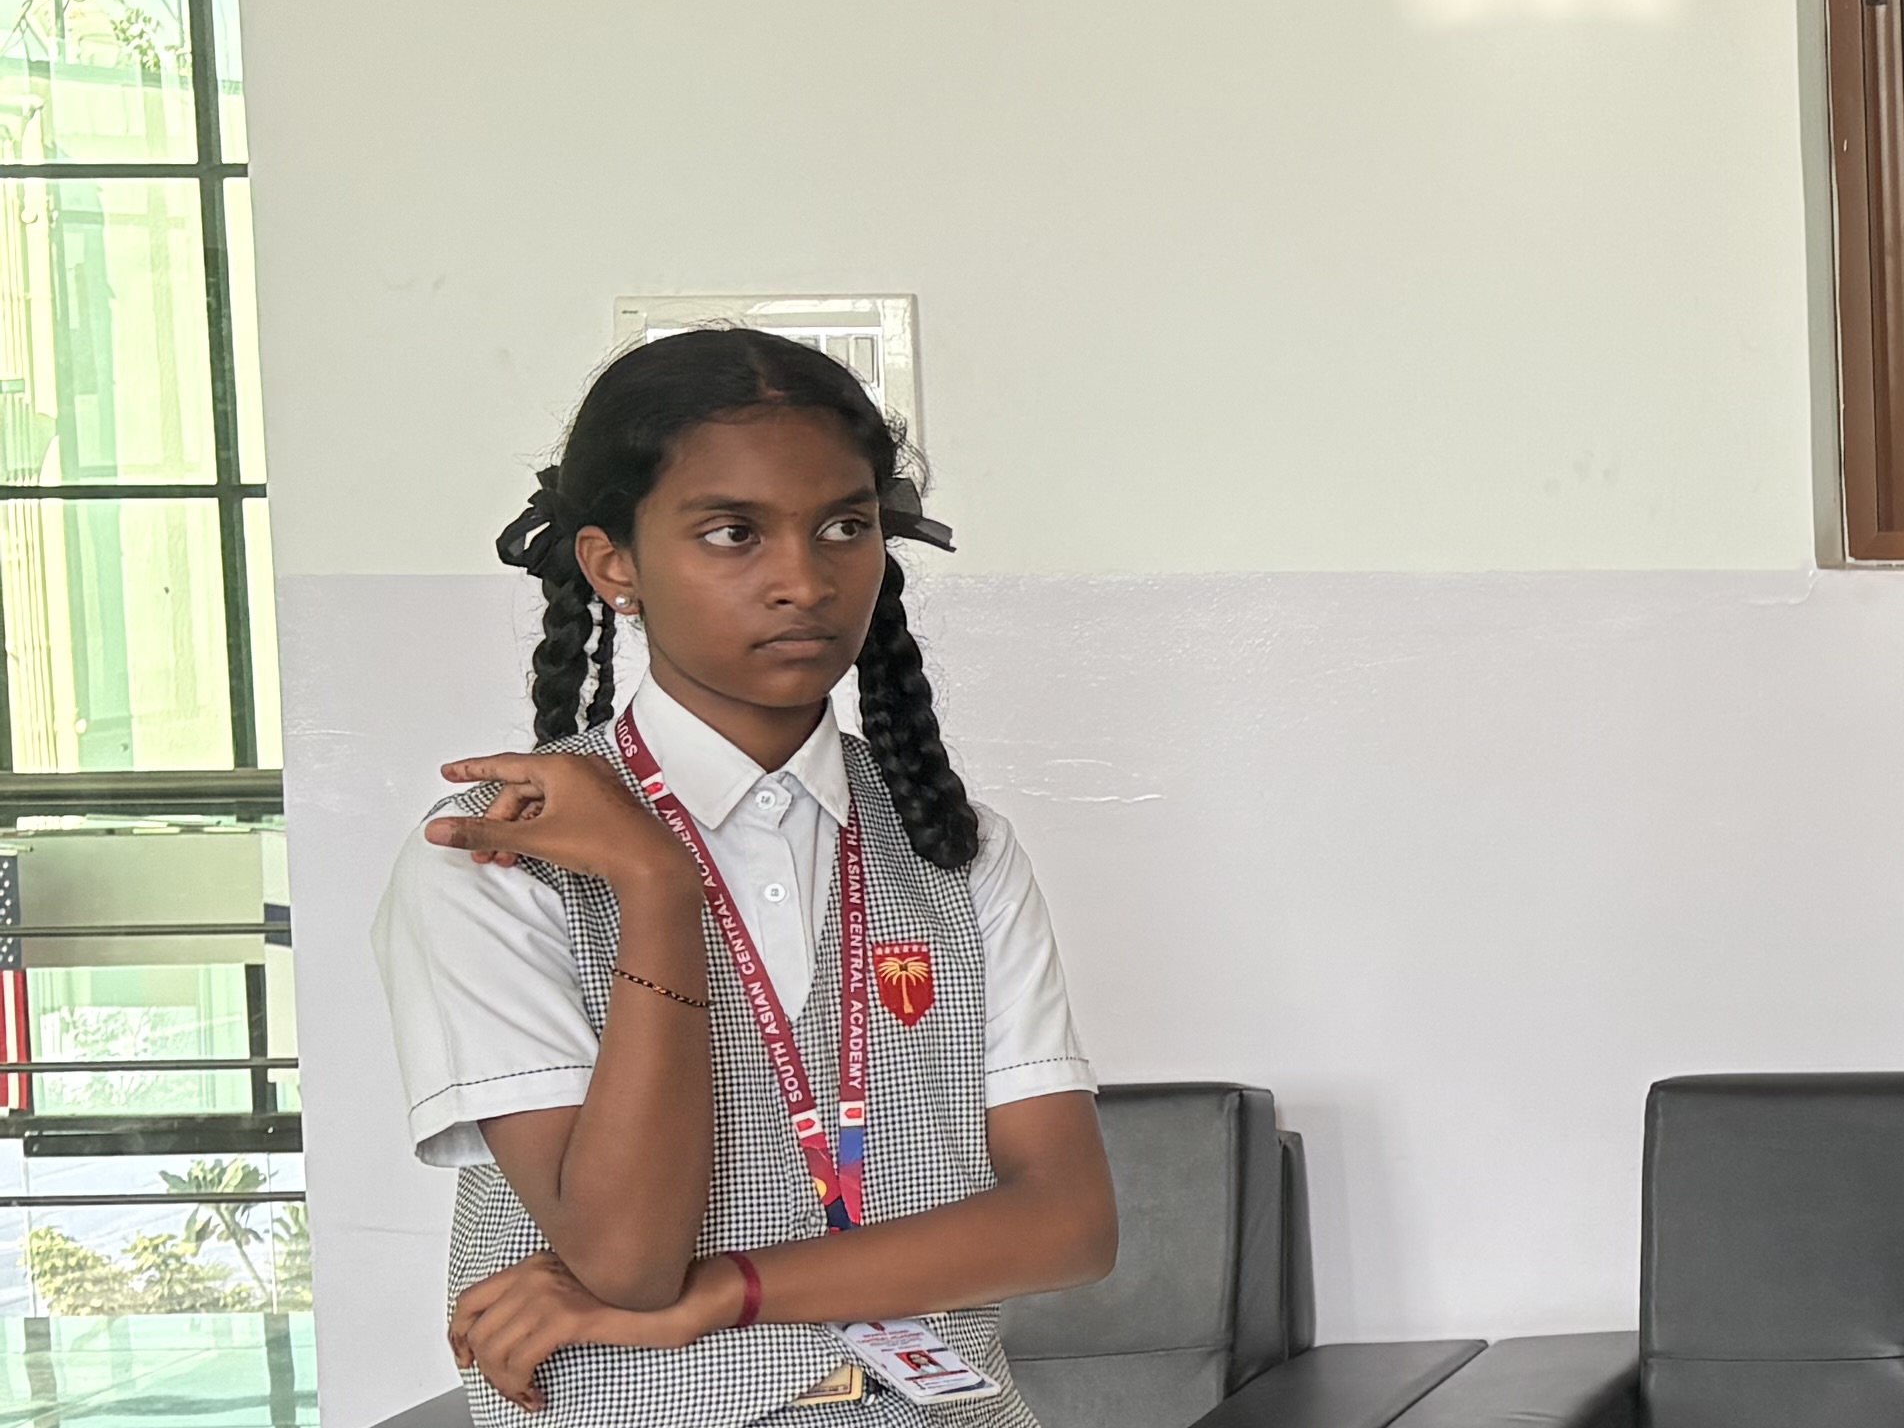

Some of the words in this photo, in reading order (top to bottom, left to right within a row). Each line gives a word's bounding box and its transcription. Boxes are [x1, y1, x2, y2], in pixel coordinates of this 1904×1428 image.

[847, 852, 861, 904] ASIAN
[713, 893, 755, 975] CENTRAL
[849, 912, 864, 992] CENTRAL
[749, 981, 780, 1035] ASIAN
[771, 1042, 803, 1103] SOUTH
[849, 1000, 864, 1089] ACADEMY
